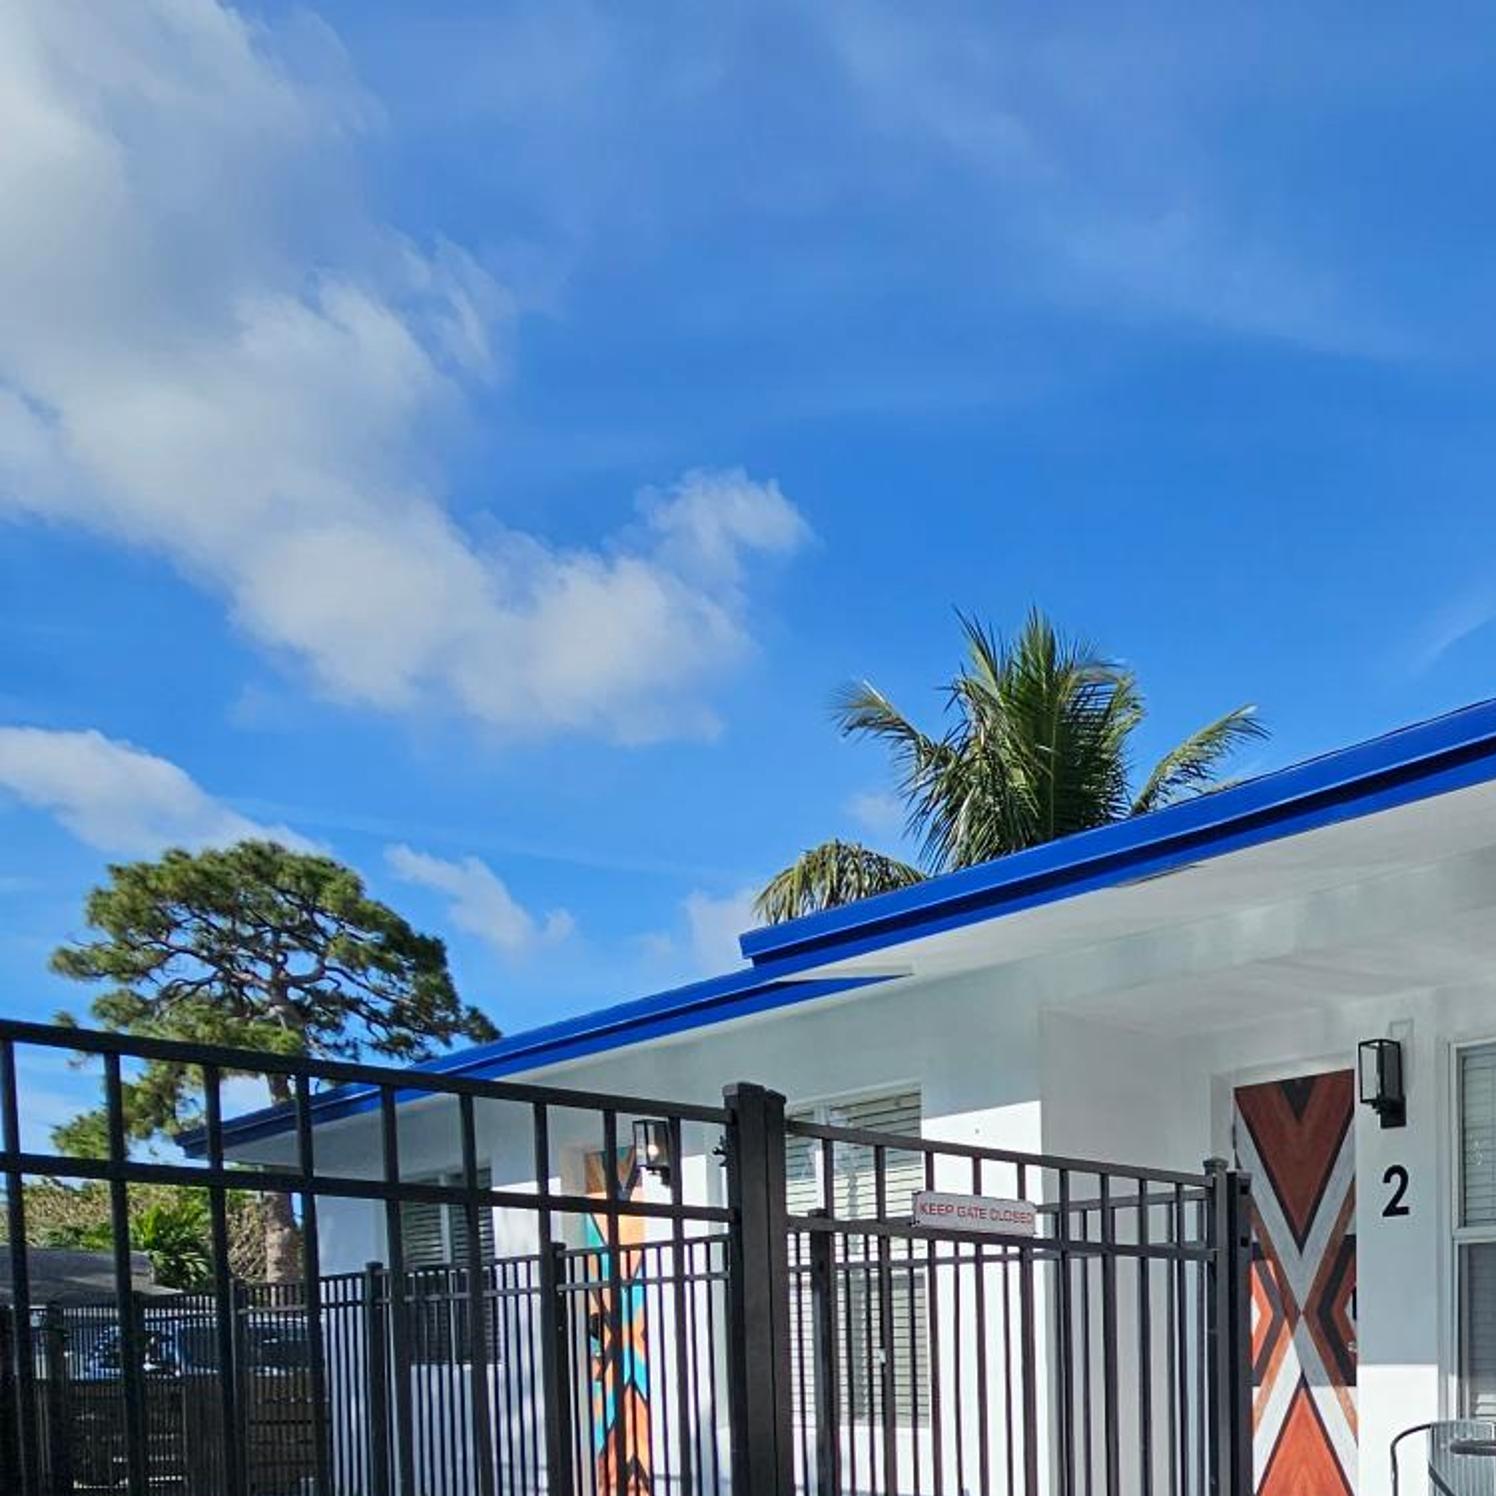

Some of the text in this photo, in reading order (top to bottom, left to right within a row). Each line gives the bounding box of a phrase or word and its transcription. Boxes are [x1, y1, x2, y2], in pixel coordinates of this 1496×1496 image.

[1382, 1164, 1410, 1217] 2
[919, 1202, 1033, 1225] KEEP GATE CLOSED
